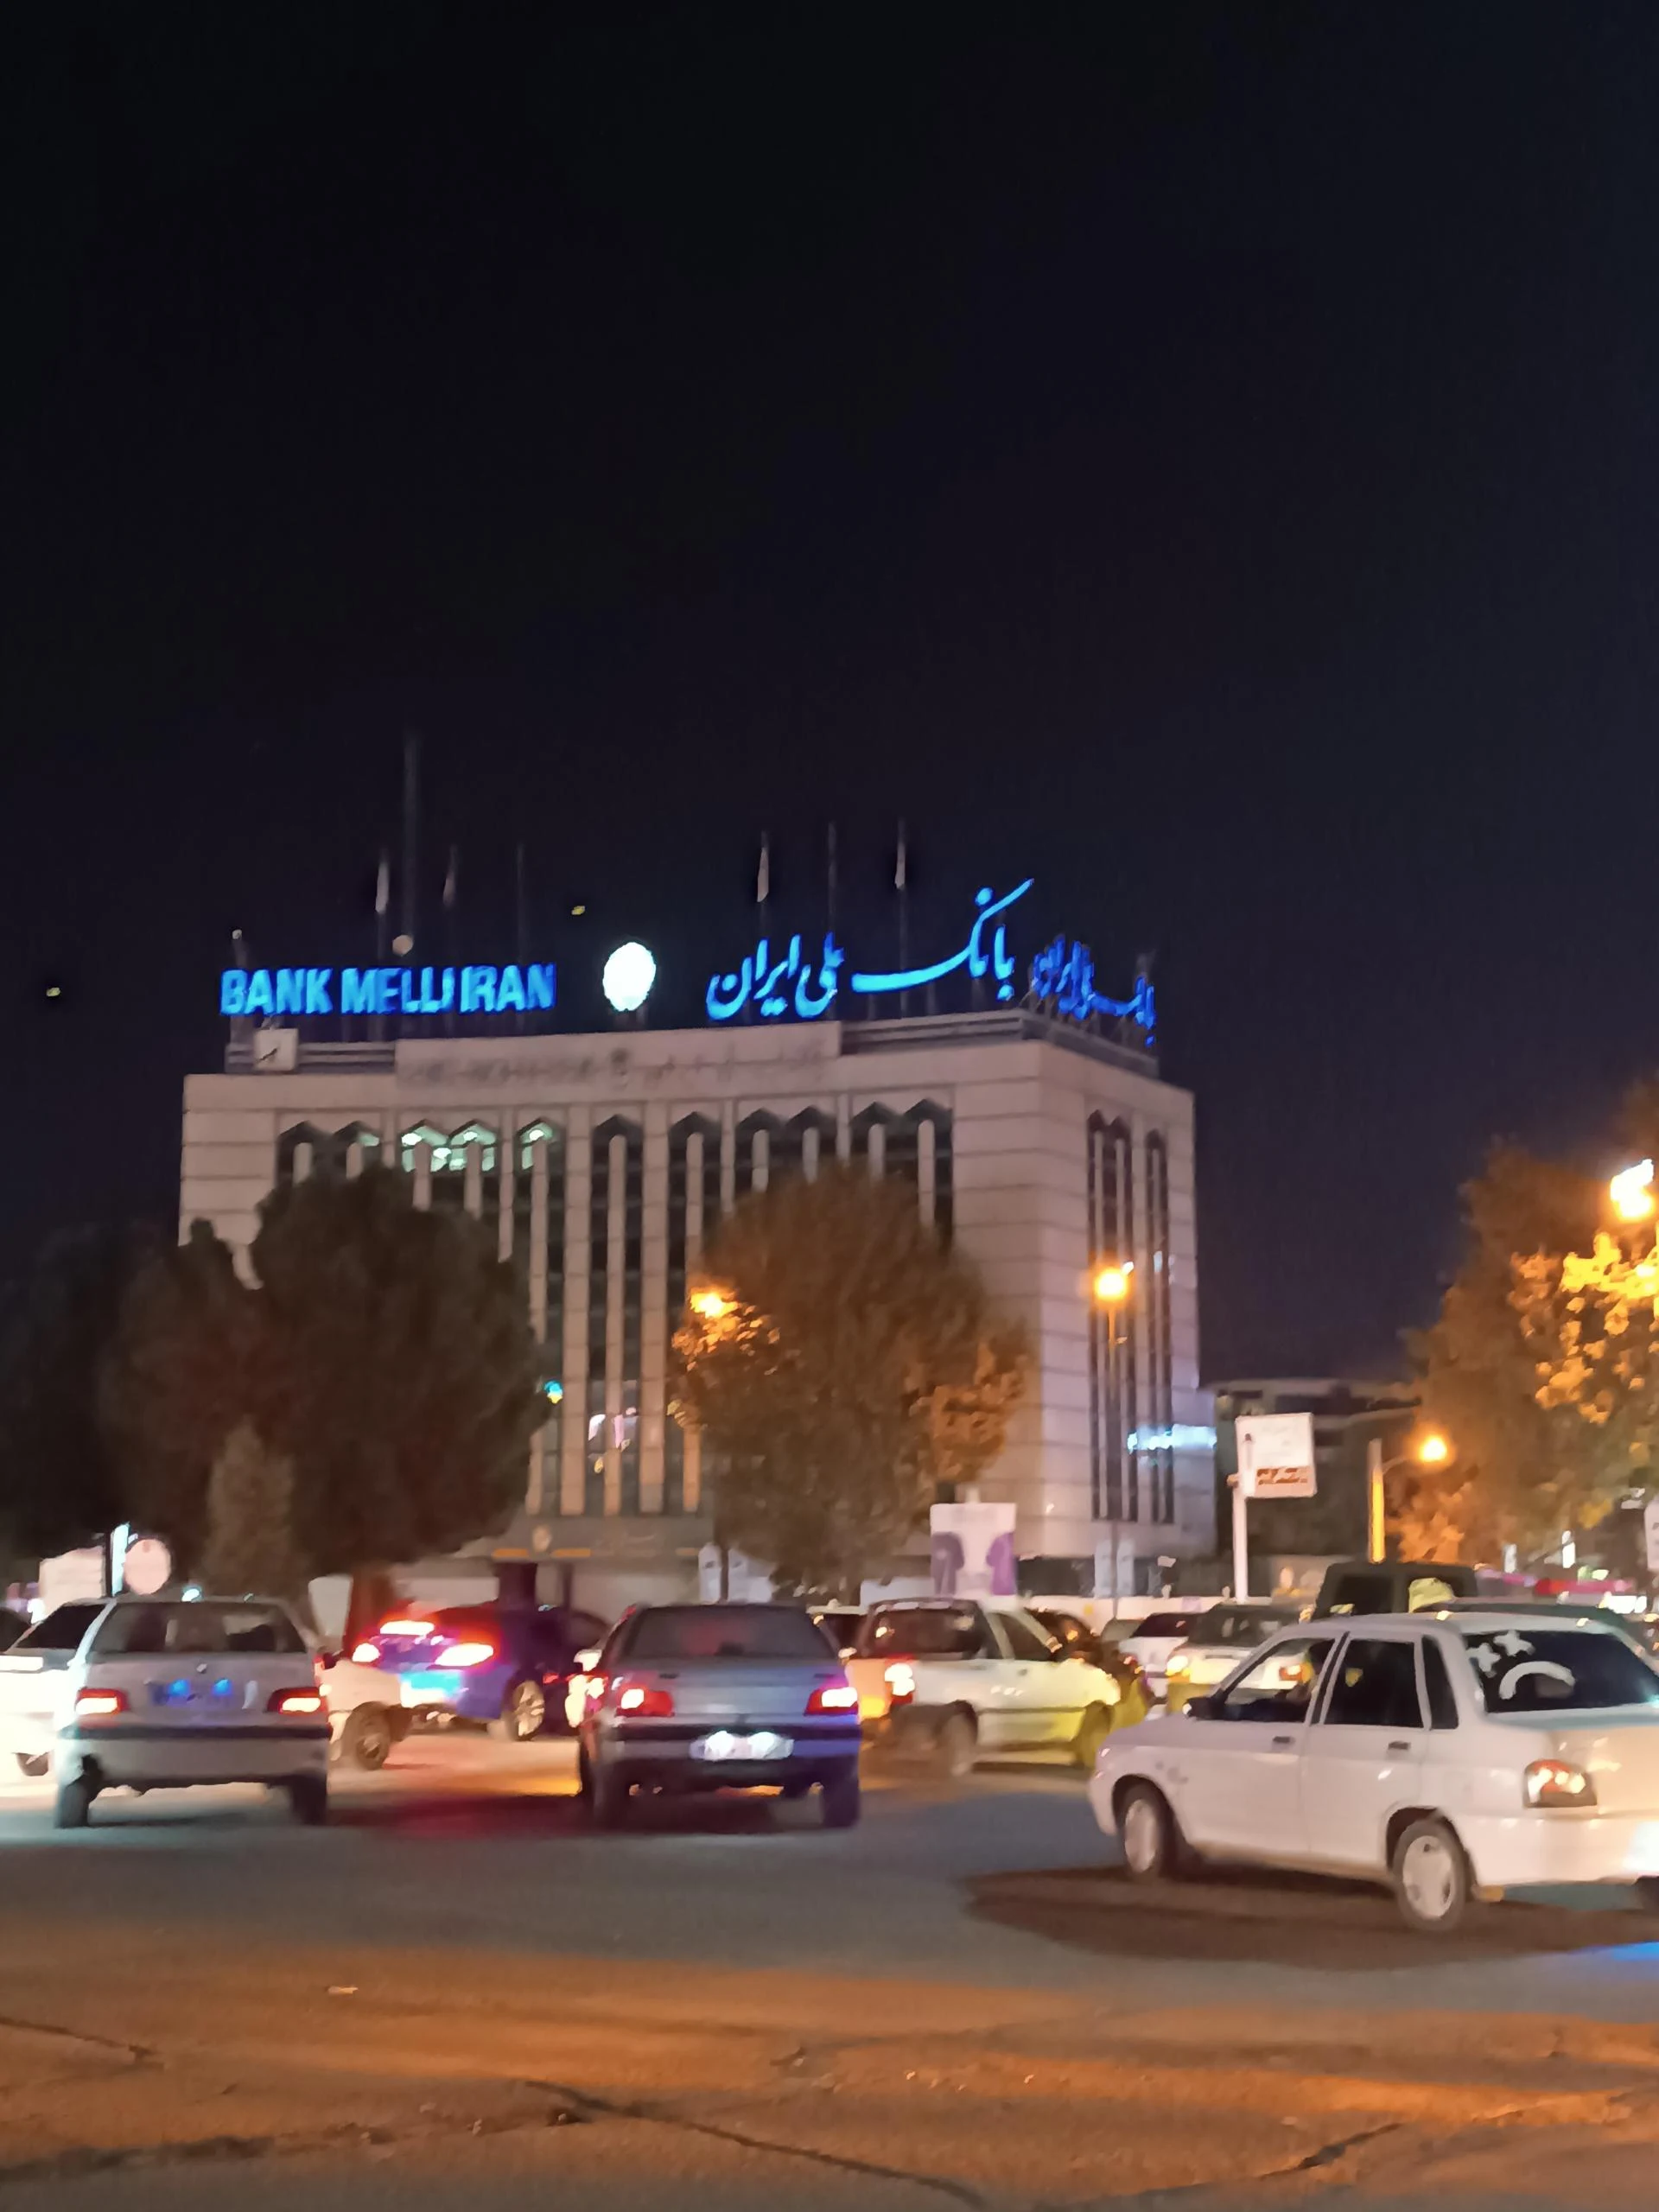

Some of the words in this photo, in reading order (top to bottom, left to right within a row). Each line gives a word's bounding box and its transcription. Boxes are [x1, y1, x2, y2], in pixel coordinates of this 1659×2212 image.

[706, 933, 802, 1020] ایران
[851, 879, 1033, 1001] بانک
[220, 968, 334, 1016] BANK
[340, 966, 456, 1015] MELLI
[460, 963, 556, 1014] IRAN
